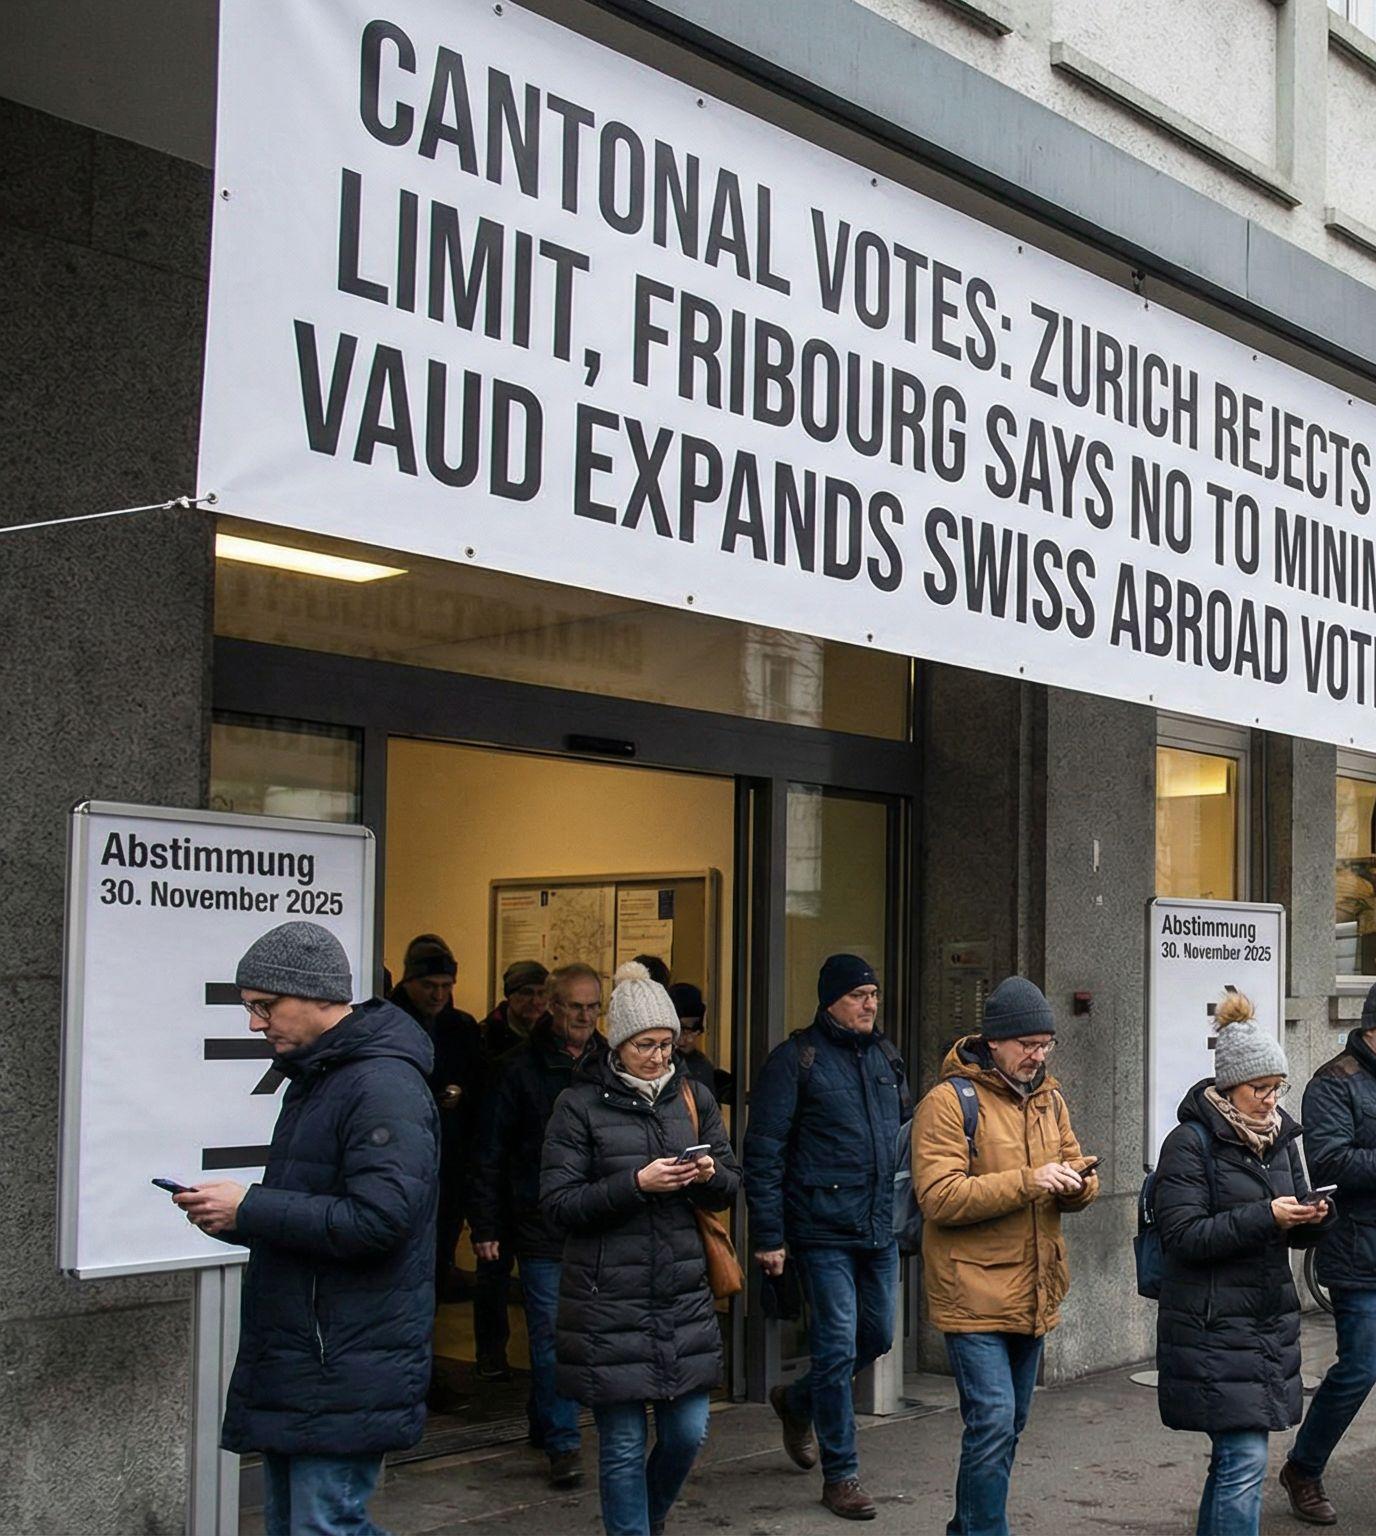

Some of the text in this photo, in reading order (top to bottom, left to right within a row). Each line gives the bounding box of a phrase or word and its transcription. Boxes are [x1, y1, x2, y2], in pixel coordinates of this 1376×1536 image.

[359, 19, 791, 297] CANTONAL
[811, 207, 1012, 380] VOTES:
[1030, 301, 1199, 451] ZURICH
[1214, 381, 1371, 516] REJECTS
[337, 167, 602, 388] LIMIT,
[632, 273, 967, 483] FRIBOURG
[985, 404, 1114, 530] SAYS
[1130, 455, 1192, 555] NO
[1206, 481, 1260, 575] TO
[293, 318, 544, 502] VAUD
[573, 402, 904, 593] EXPANDS
[923, 506, 1096, 639] SWISS
[1109, 562, 1288, 685] ABROAD
[100, 831, 315, 887] Abstimmung
[100, 878, 344, 916] 30. November 2025
[1161, 913, 1257, 944] Abstimmung
[1161, 941, 1272, 962] 30. November 2025
